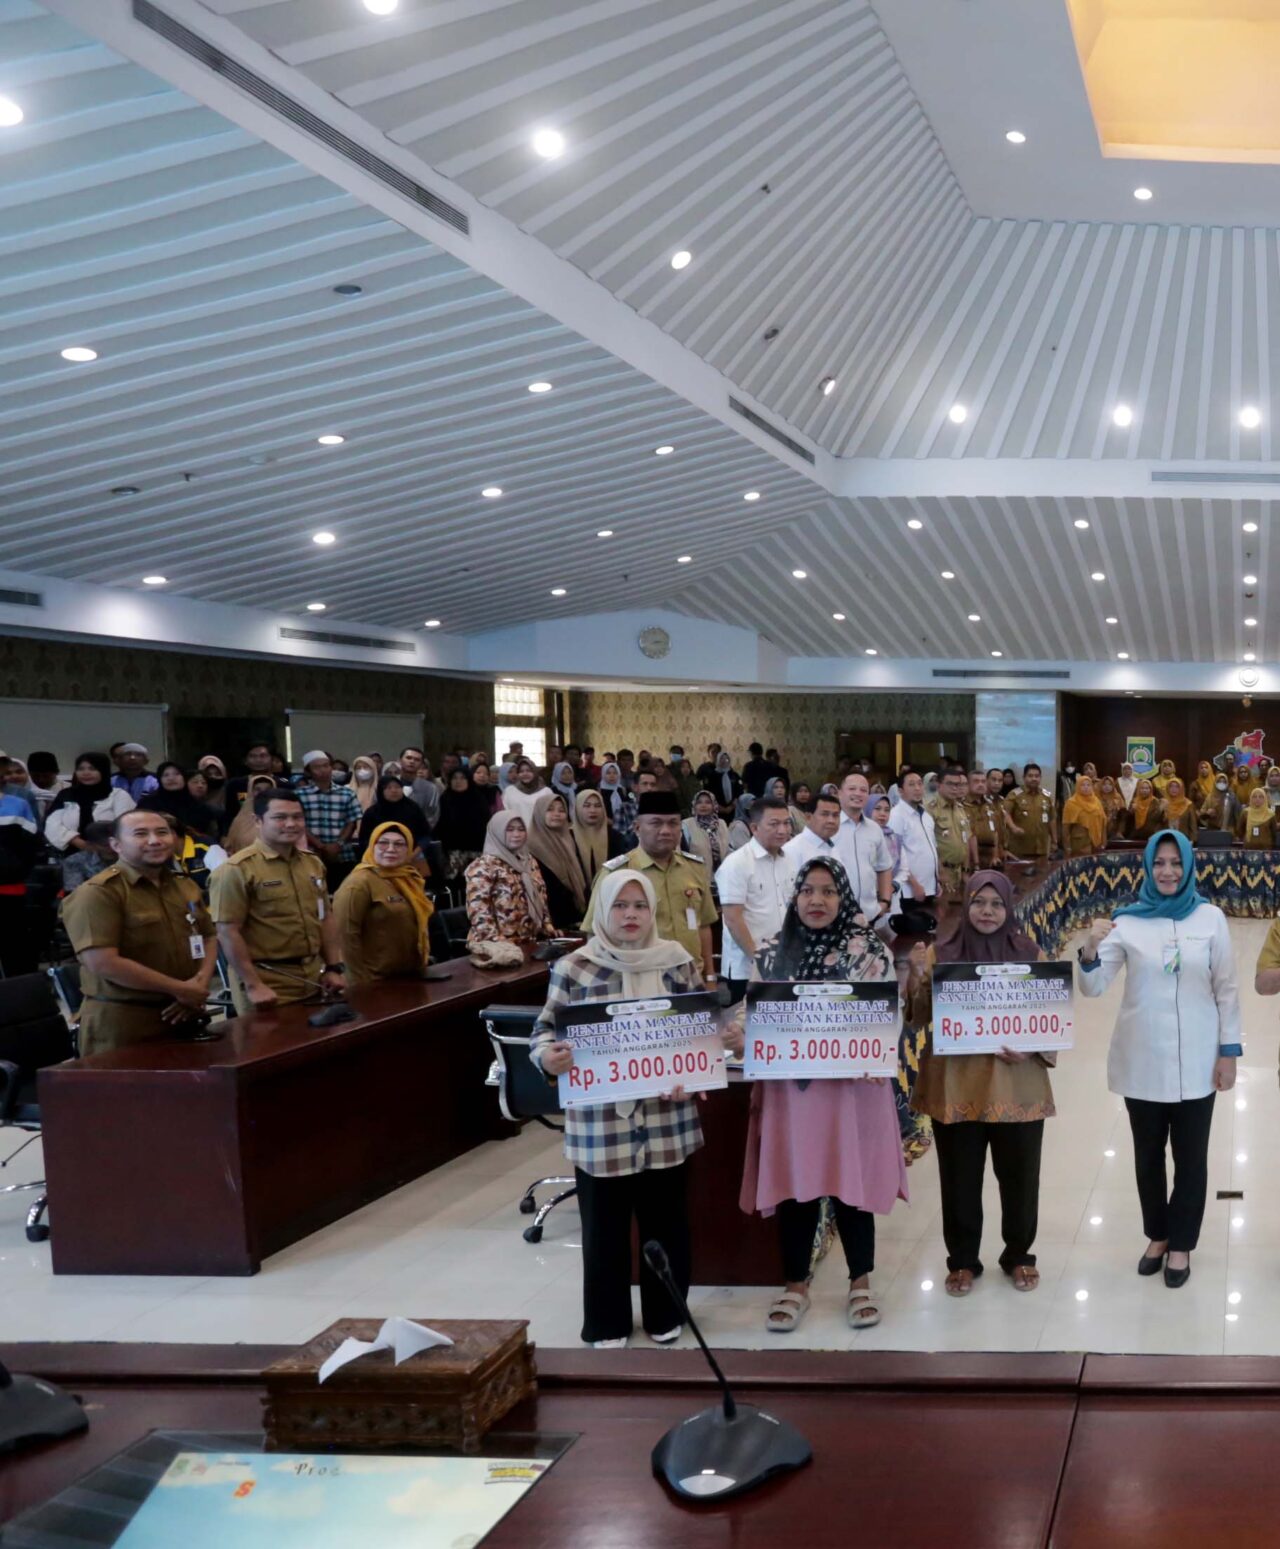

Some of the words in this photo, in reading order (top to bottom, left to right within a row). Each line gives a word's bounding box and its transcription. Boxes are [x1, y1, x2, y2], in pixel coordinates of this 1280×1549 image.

[942, 981, 1004, 992] PENERIMA
[1008, 979, 1064, 990] MANFAAT
[938, 992, 1003, 1002] SANTUNAN
[1007, 990, 1068, 1001] KEMATIAN
[757, 1001, 823, 1012] PENERIMA
[827, 1001, 888, 1011] MANFAAT
[567, 1020, 641, 1037] PENERIMA
[646, 1012, 711, 1028] MANFAAT
[752, 1013, 822, 1024] SANTUNAN
[825, 1012, 893, 1023] KEMATIAN
[645, 1024, 716, 1040] KEMATIAN
[942, 1018, 968, 1040] Rp.
[975, 1014, 1072, 1037] 3.000.000,-
[592, 1047, 620, 1056] TAHUN
[624, 1043, 670, 1053] ANGGARAN
[754, 1039, 782, 1064] Rp.
[789, 1039, 895, 1063] 3.000.000,-
[569, 1066, 601, 1091] Rp.
[608, 1051, 722, 1083] 3.000.000,-
